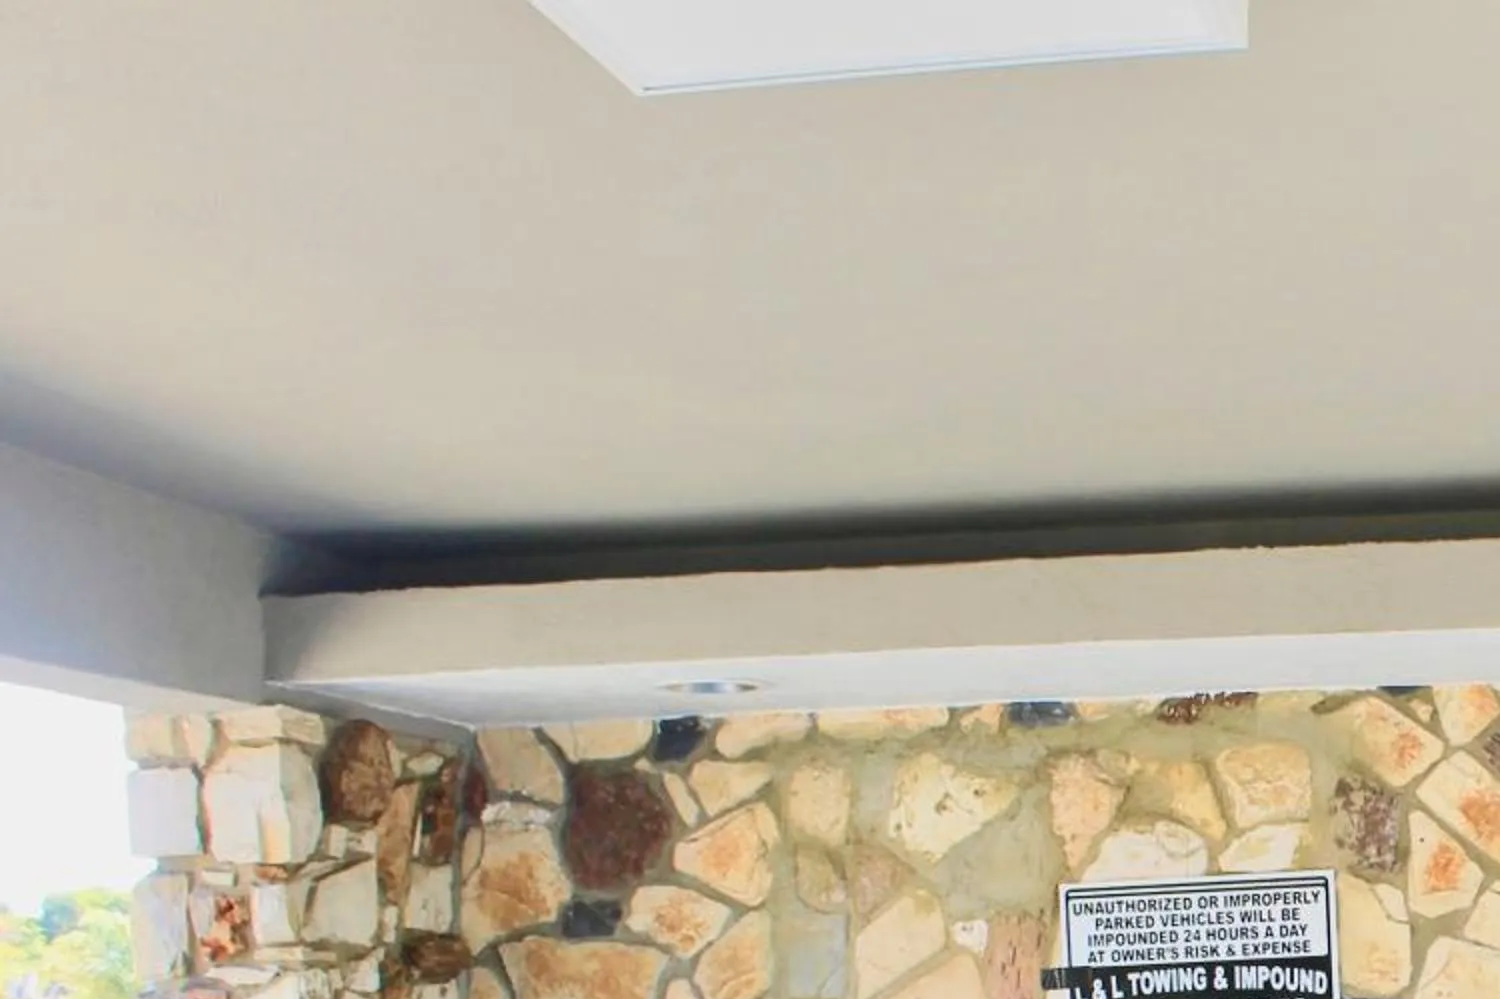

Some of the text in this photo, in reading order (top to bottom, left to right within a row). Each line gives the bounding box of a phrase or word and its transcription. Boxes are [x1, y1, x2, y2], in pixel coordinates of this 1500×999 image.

[1072, 890, 1321, 916] UNAUTHORIZED OR IMPROPERLY
[1095, 907, 1301, 930] PARKED VEHICLES WILL BE
[1087, 924, 1308, 947] IMPOUNDED 24 HOURS A DAY
[1087, 940, 1312, 964] AT OWNER'S RISK & EXPENSE
[1110, 975, 1124, 999] L
[1127, 966, 1208, 996] TOWING
[1213, 966, 1229, 990] &
[1234, 965, 1328, 995] IMPOUND
